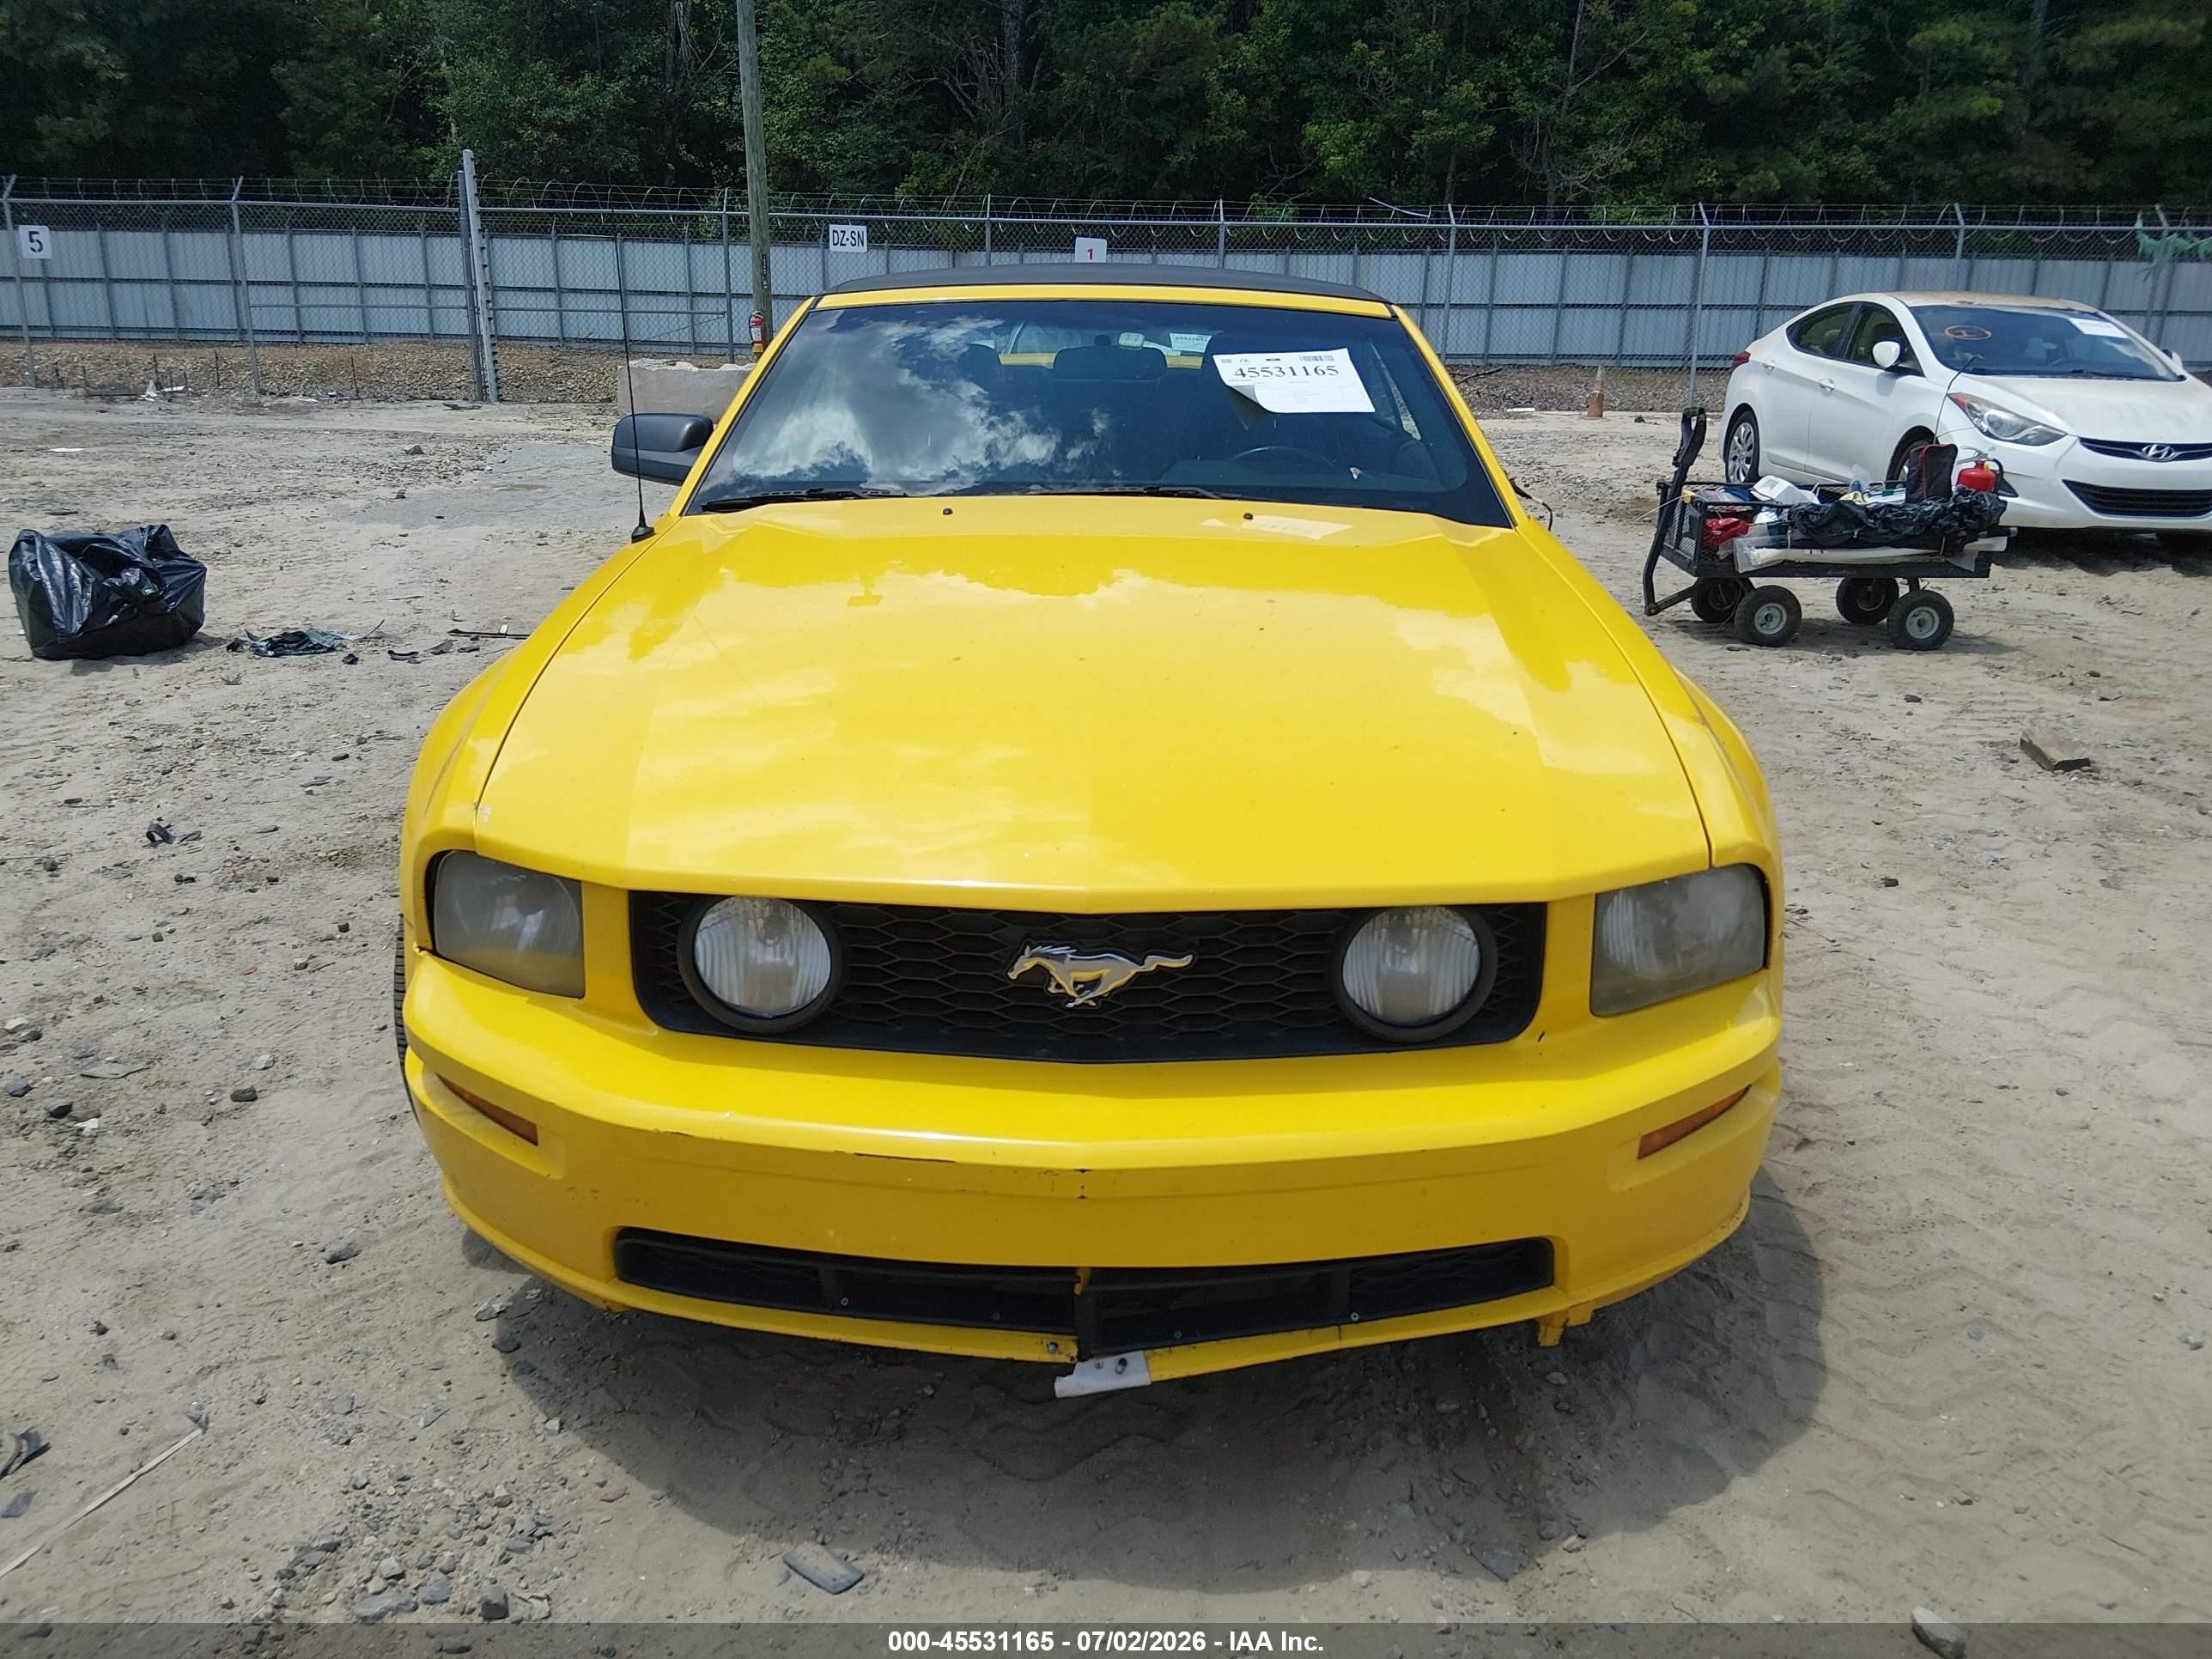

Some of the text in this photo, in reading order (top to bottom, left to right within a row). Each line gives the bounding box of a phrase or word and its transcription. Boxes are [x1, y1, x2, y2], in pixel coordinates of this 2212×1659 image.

[28, 230, 44, 253] 5
[1087, 248, 1093, 260] 1
[1234, 365, 1340, 379] 45531165
